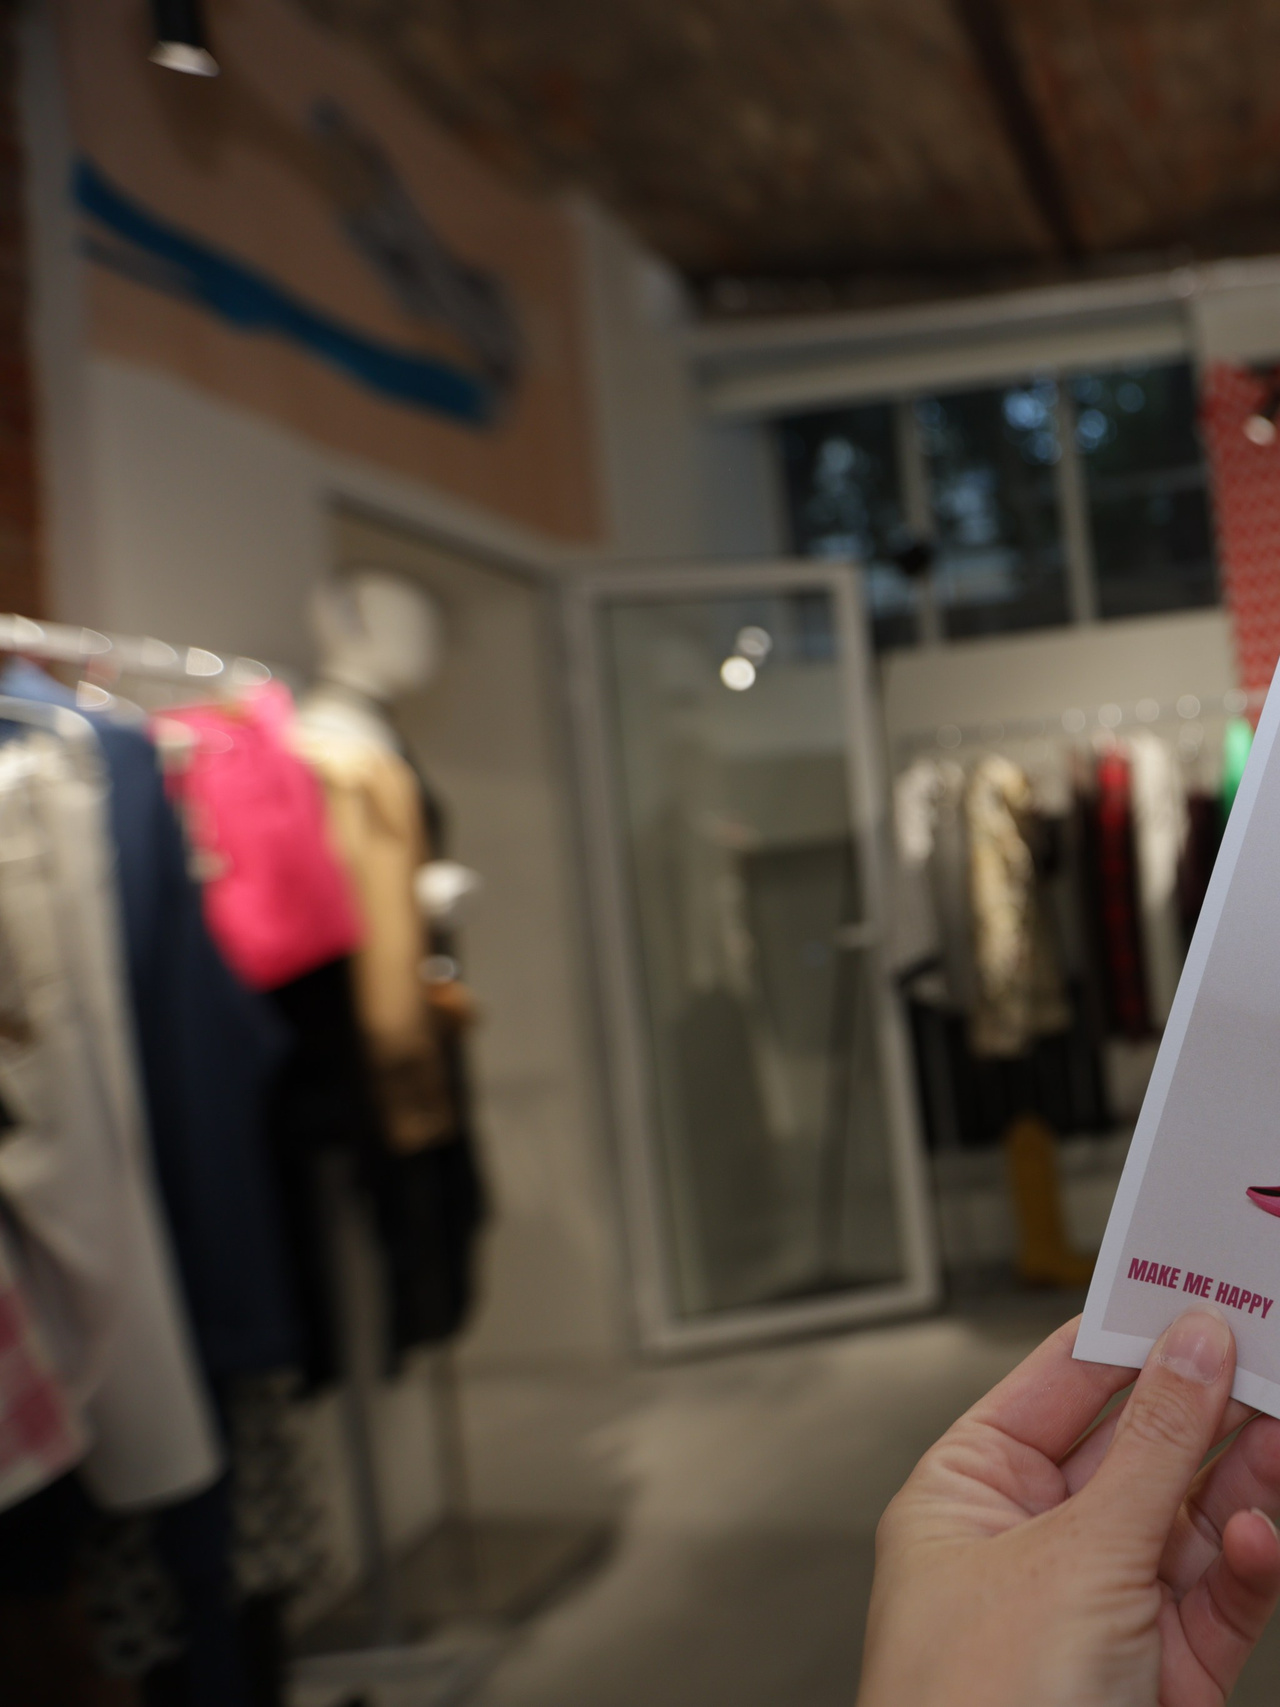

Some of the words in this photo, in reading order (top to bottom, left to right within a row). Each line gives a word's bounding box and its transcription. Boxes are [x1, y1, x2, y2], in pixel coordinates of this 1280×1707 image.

[1127, 1257, 1181, 1289] MAKE
[1182, 1272, 1214, 1298] ME
[1214, 1281, 1274, 1319] HAPPY
